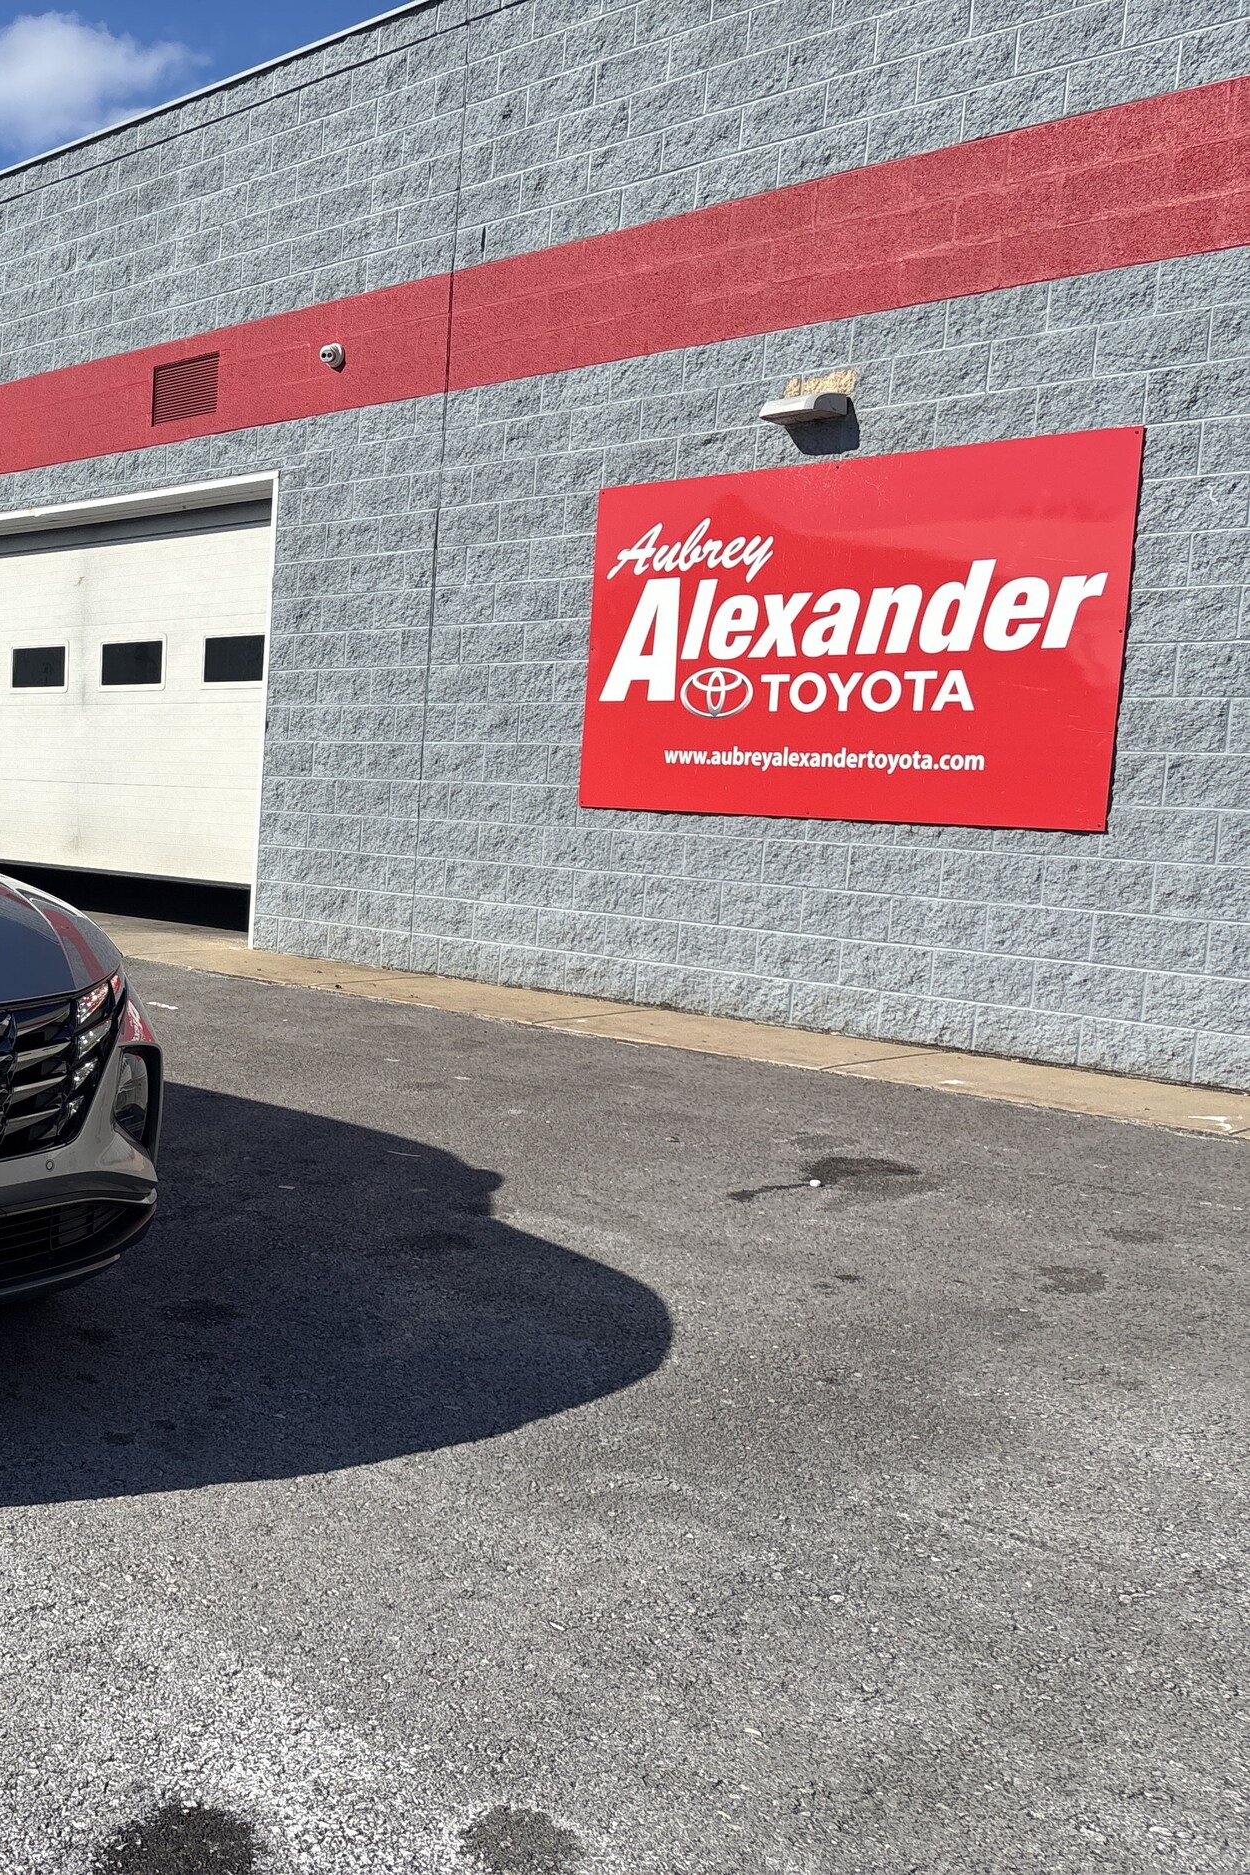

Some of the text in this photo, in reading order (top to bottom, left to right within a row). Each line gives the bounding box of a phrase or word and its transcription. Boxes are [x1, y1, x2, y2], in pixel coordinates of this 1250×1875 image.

[606, 517, 774, 583] Aubrey
[598, 558, 1109, 702] Alexander
[760, 669, 975, 713] TOYOTA
[664, 745, 985, 775] www.aubreyalexandertoyota.com
